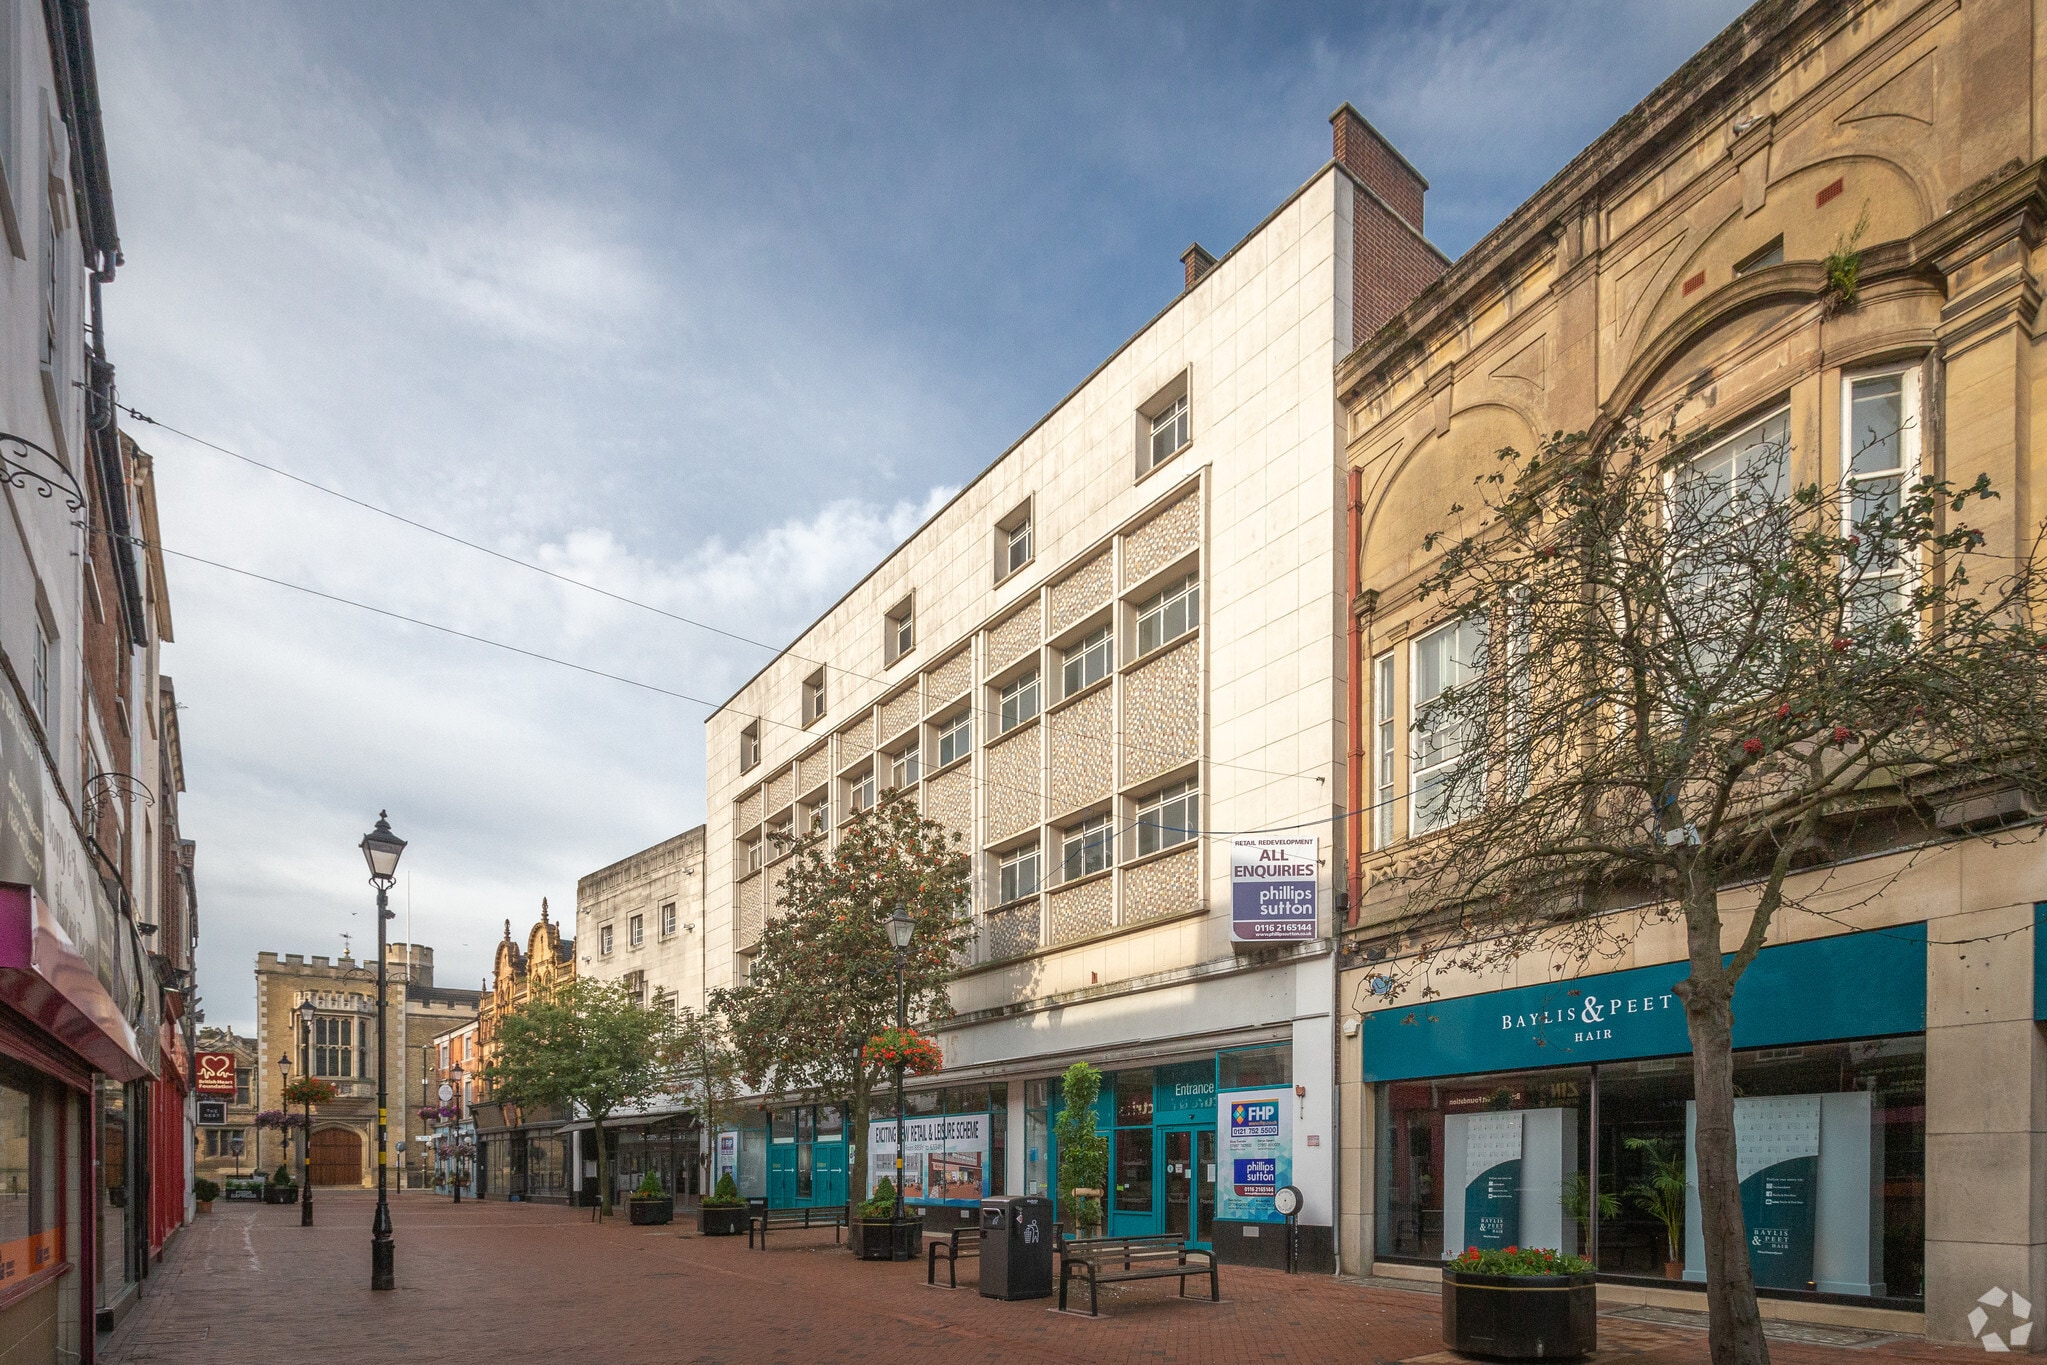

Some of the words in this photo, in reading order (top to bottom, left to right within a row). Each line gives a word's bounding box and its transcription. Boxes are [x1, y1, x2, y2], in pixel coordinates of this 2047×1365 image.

[1259, 849, 1289, 862] ALL
[1234, 864, 1314, 879] ENQUIRIES
[1260, 886, 1312, 904] phillips
[1260, 901, 1312, 915] sutton
[1254, 924, 1274, 932] 0116
[1276, 923, 1312, 931] 2165144
[1502, 1007, 1576, 1030] BAYLIS
[1581, 995, 1605, 1024] &
[1609, 994, 1672, 1015] PEET
[1574, 1029, 1612, 1043] HAIR
[1175, 1083, 1214, 1096] Entrance
[1248, 1105, 1275, 1121] FHP
[876, 1126, 897, 1143] EXCITING
[910, 1124, 927, 1142] RETAIL
[928, 1124, 934, 1141] &
[934, 1122, 955, 1141] LEISURE
[956, 1121, 979, 1139] SCHEME
[1260, 1126, 1277, 1134] 5500
[1246, 1161, 1274, 1174] phillips
[1247, 1172, 1274, 1182] sutton
[1479, 1223, 1487, 1232] &
[1754, 1229, 1789, 1237] BAYLIS
[1752, 1235, 1762, 1246] &
